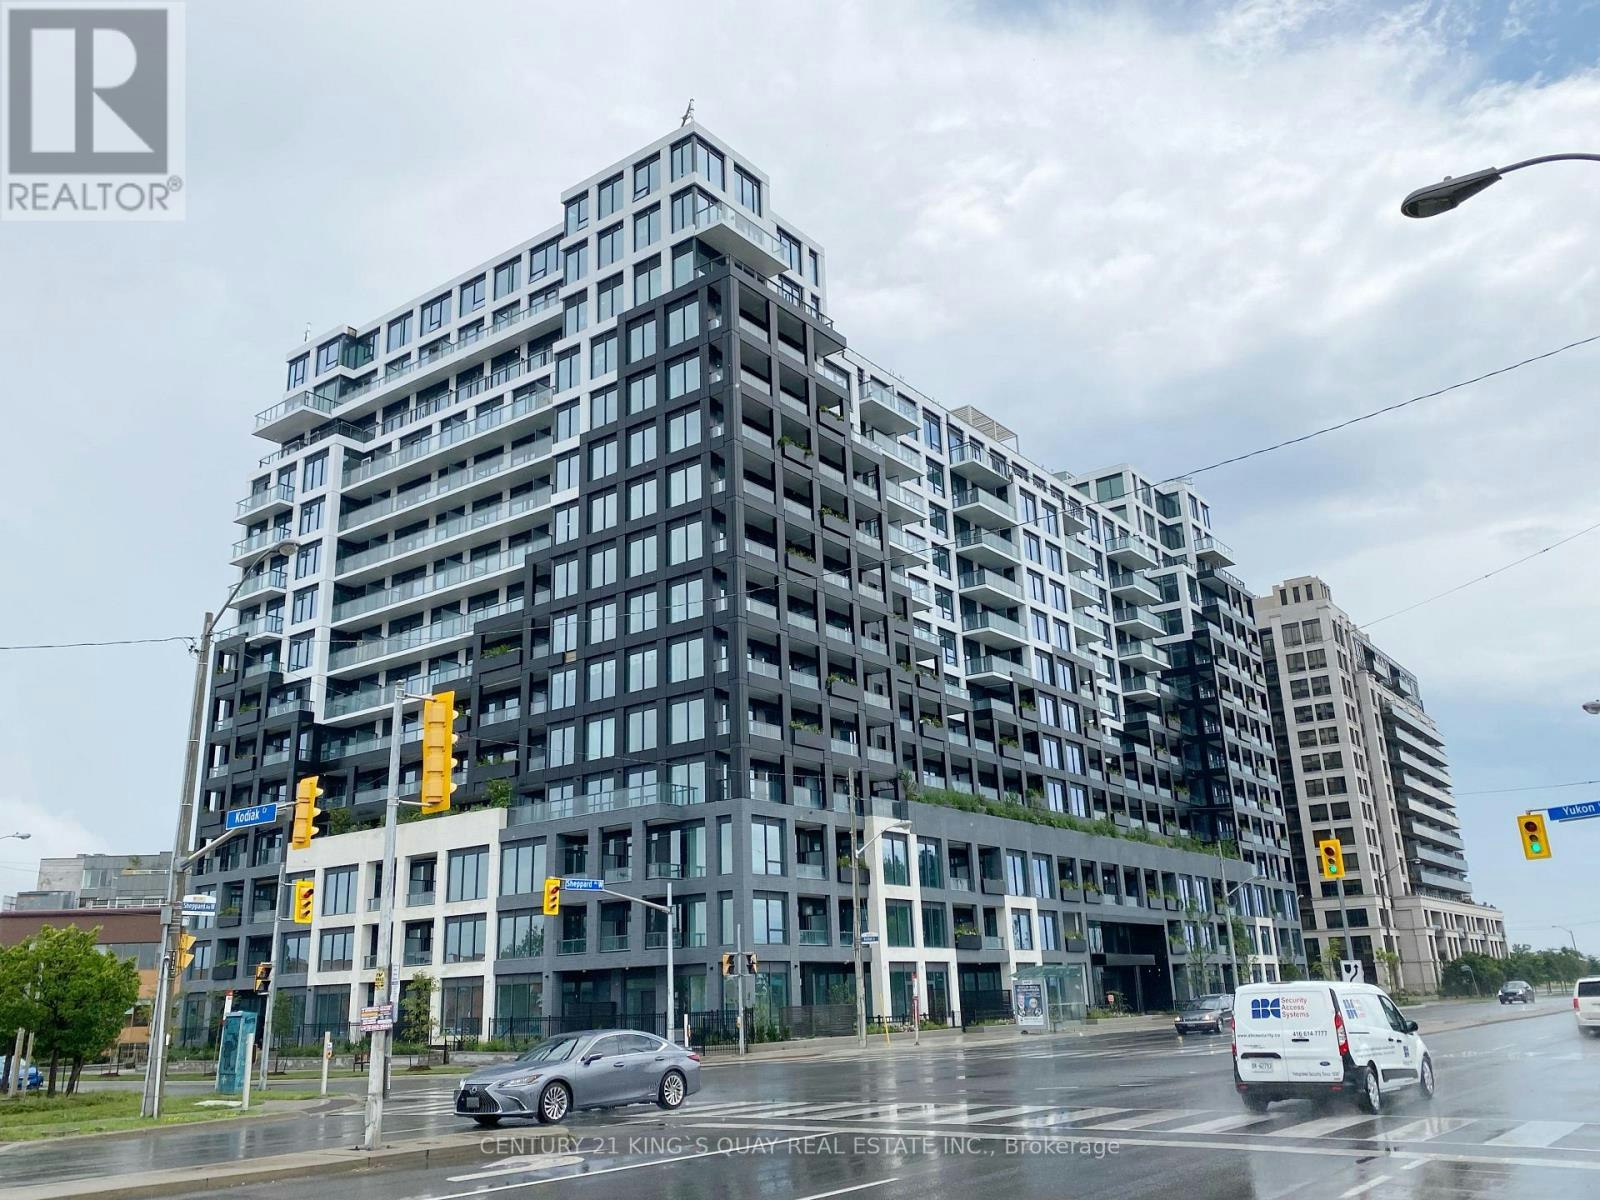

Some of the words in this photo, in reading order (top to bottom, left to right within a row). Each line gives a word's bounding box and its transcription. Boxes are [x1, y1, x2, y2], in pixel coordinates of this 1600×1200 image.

[1562, 804, 1596, 816] Yukon
[235, 809, 260, 823] Kodiak
[566, 880, 593, 889] Sheppard
[1281, 997, 1307, 1005] Security
[1282, 1011, 1310, 1019] Systems
